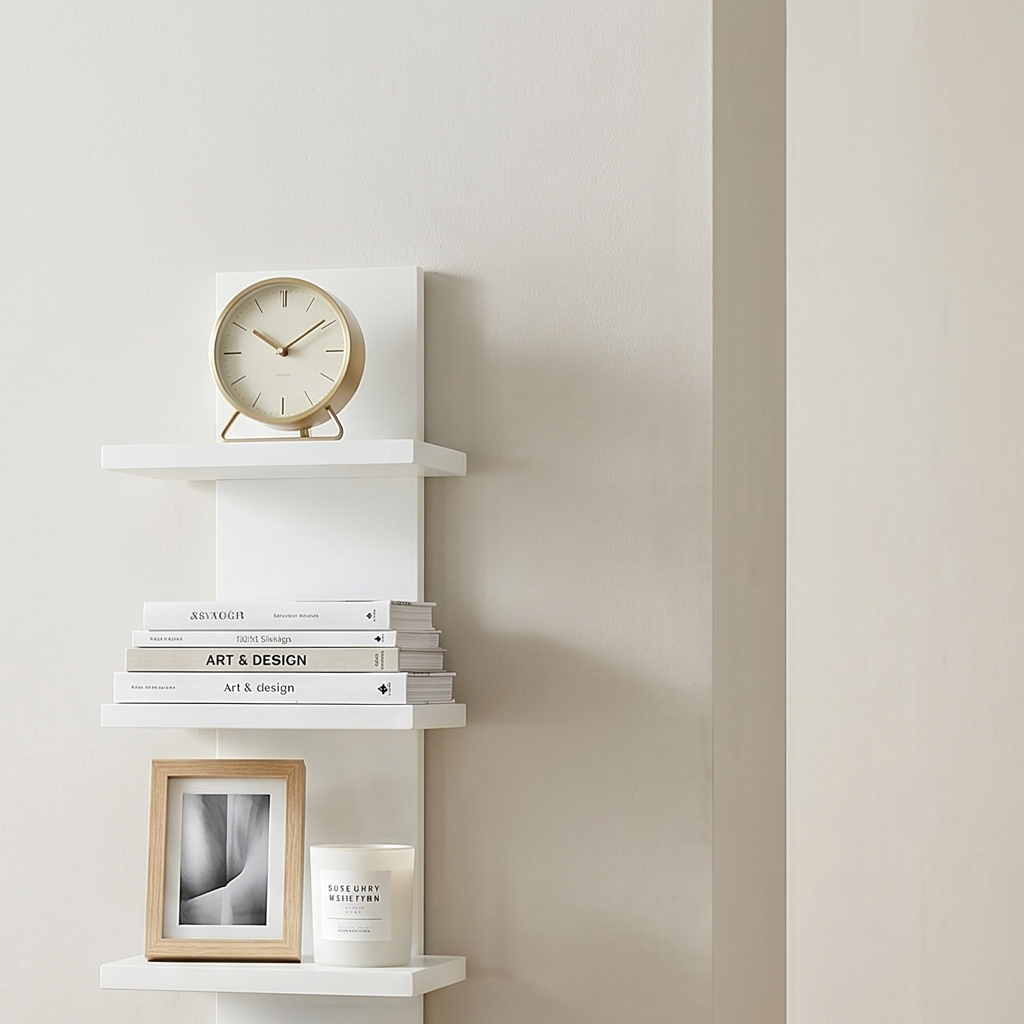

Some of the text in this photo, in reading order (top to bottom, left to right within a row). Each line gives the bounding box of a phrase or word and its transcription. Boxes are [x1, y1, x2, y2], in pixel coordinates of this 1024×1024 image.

[205, 654, 307, 666] ART & DESIGN
[223, 682, 295, 696] Art & design
